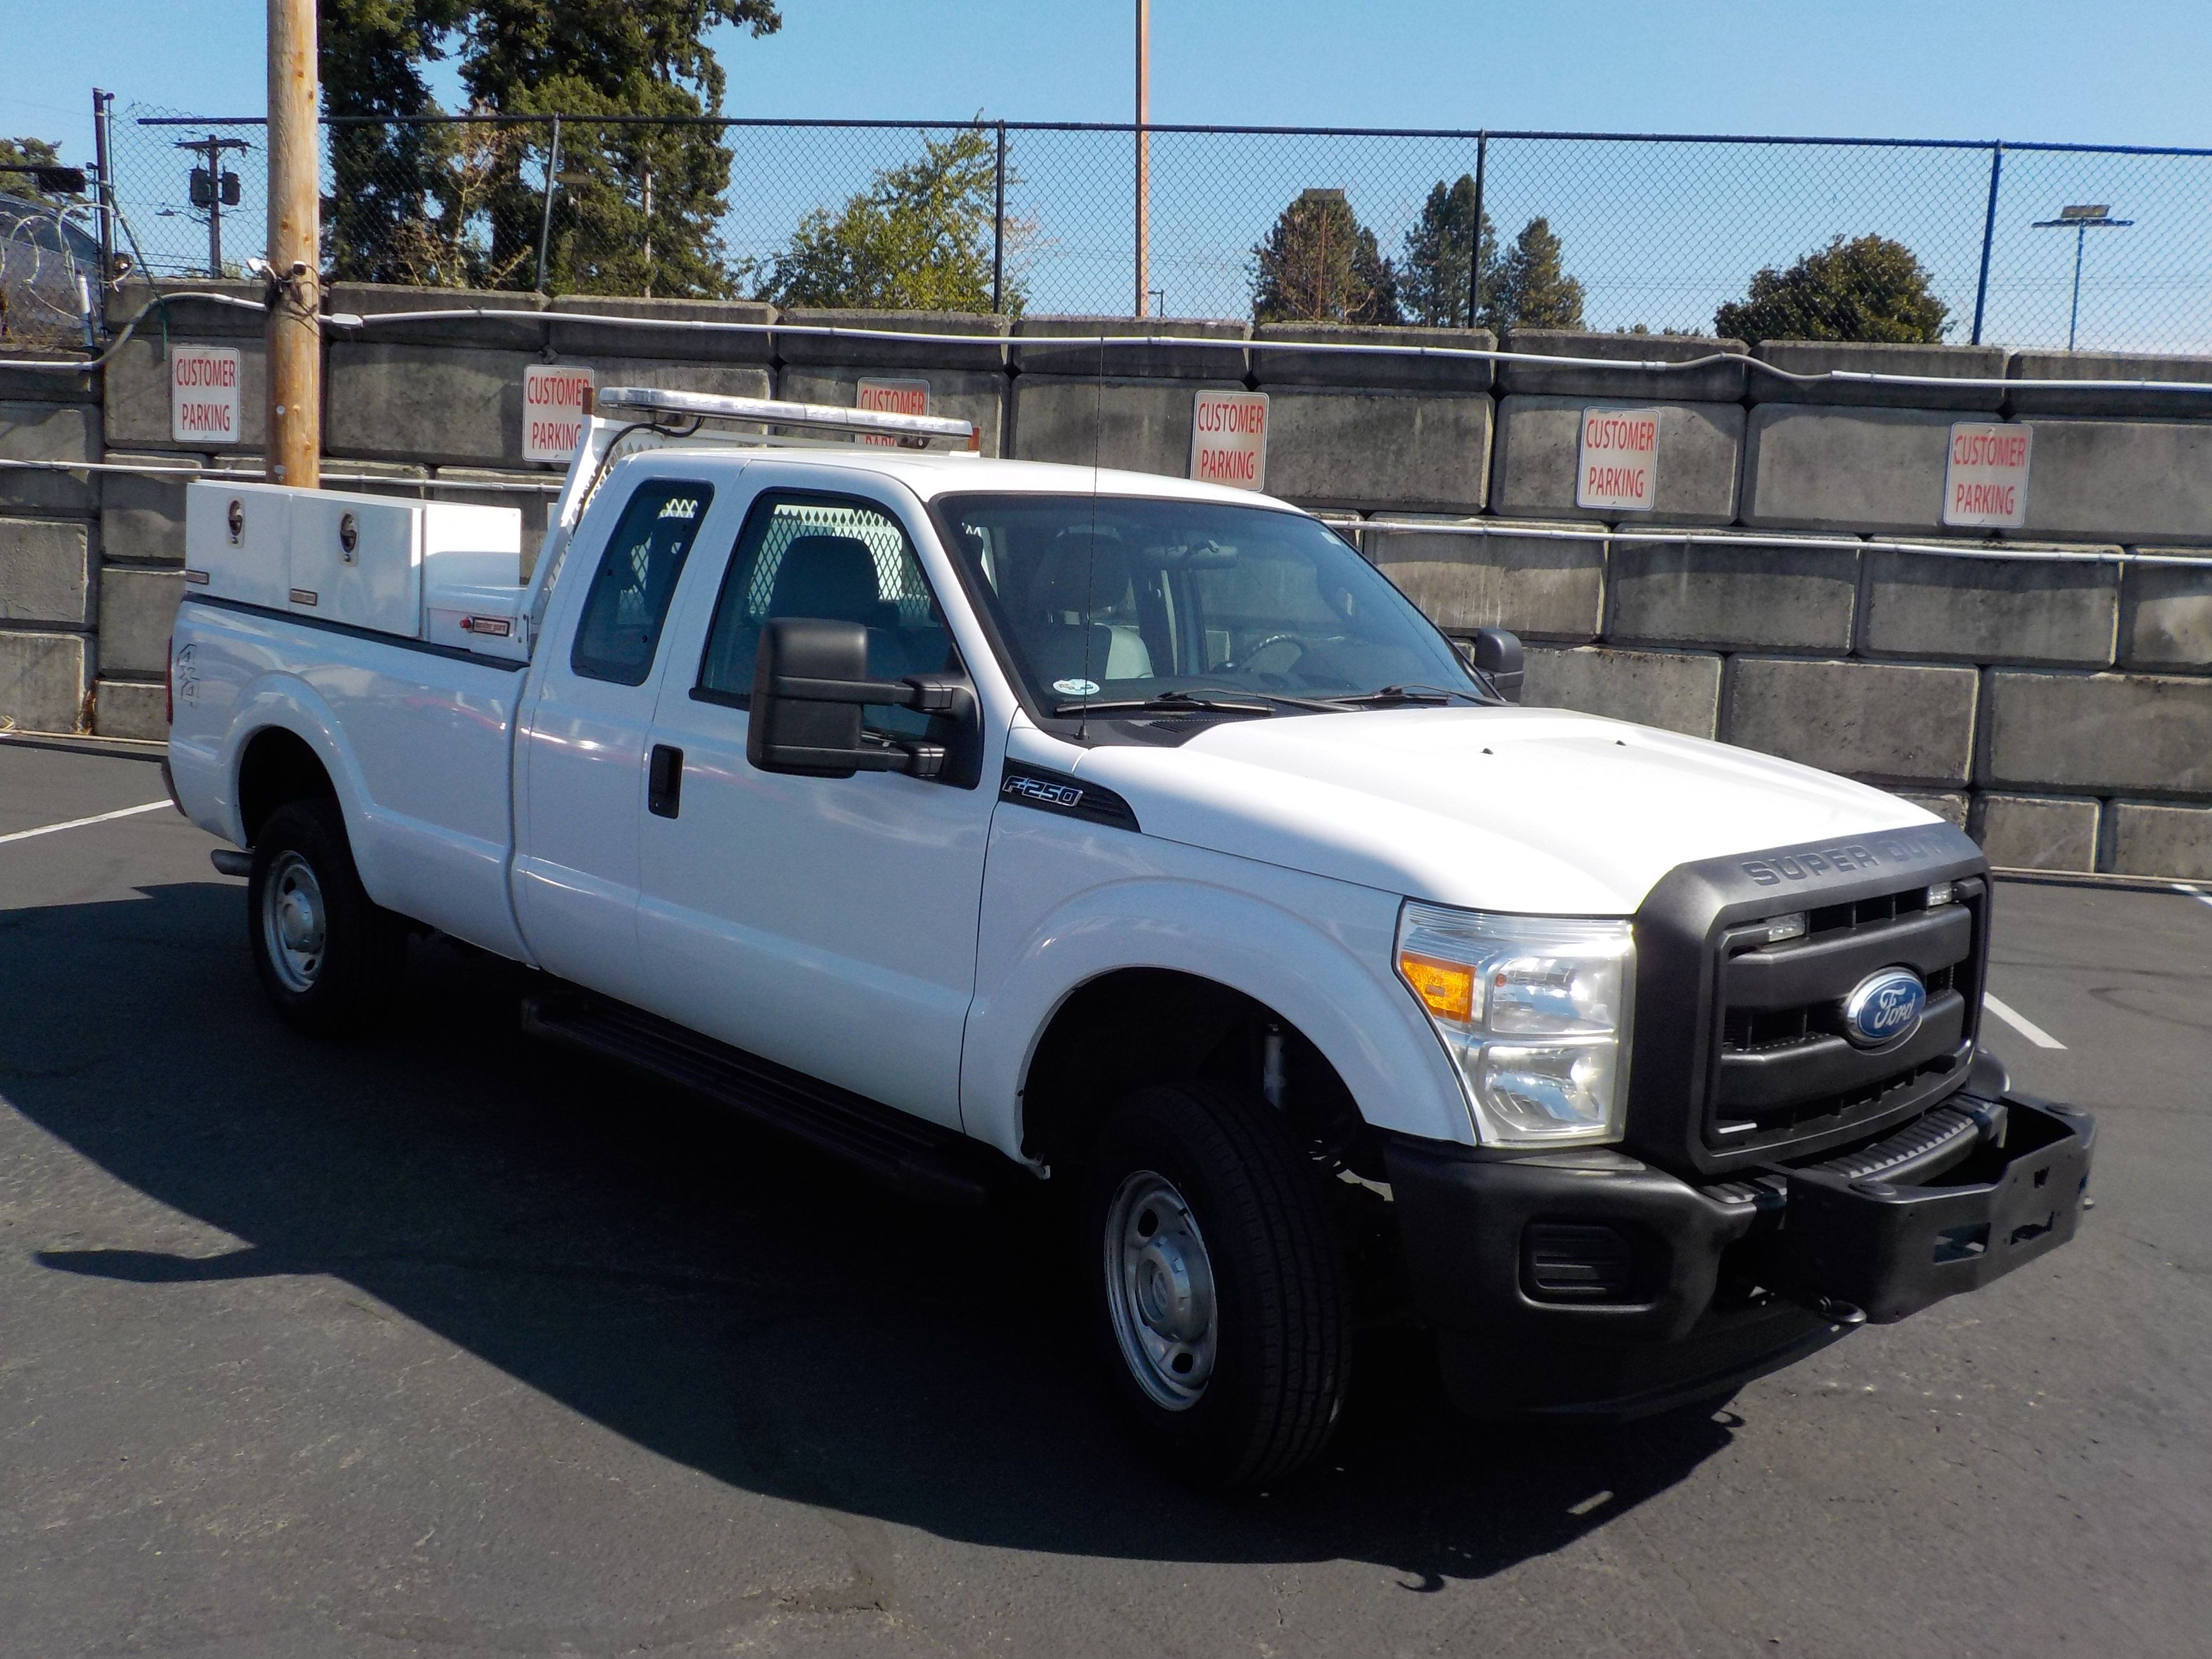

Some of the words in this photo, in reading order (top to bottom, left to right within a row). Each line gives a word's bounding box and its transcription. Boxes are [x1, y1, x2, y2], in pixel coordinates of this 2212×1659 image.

[177, 358, 236, 387] CUSTOMER
[182, 404, 230, 431] PARKING
[1199, 403, 1263, 433] CUSTOMER
[1586, 419, 1654, 451] CUSTOMER
[1954, 435, 2026, 466] CUSTOMER
[1201, 449, 1254, 480] PARKING
[1588, 466, 1645, 498] PARKING
[1956, 484, 2015, 515] PARKING
[1002, 775, 1084, 807] F-250
[1741, 845, 1880, 886] SUPER
[1874, 986, 1916, 1029] Ford
